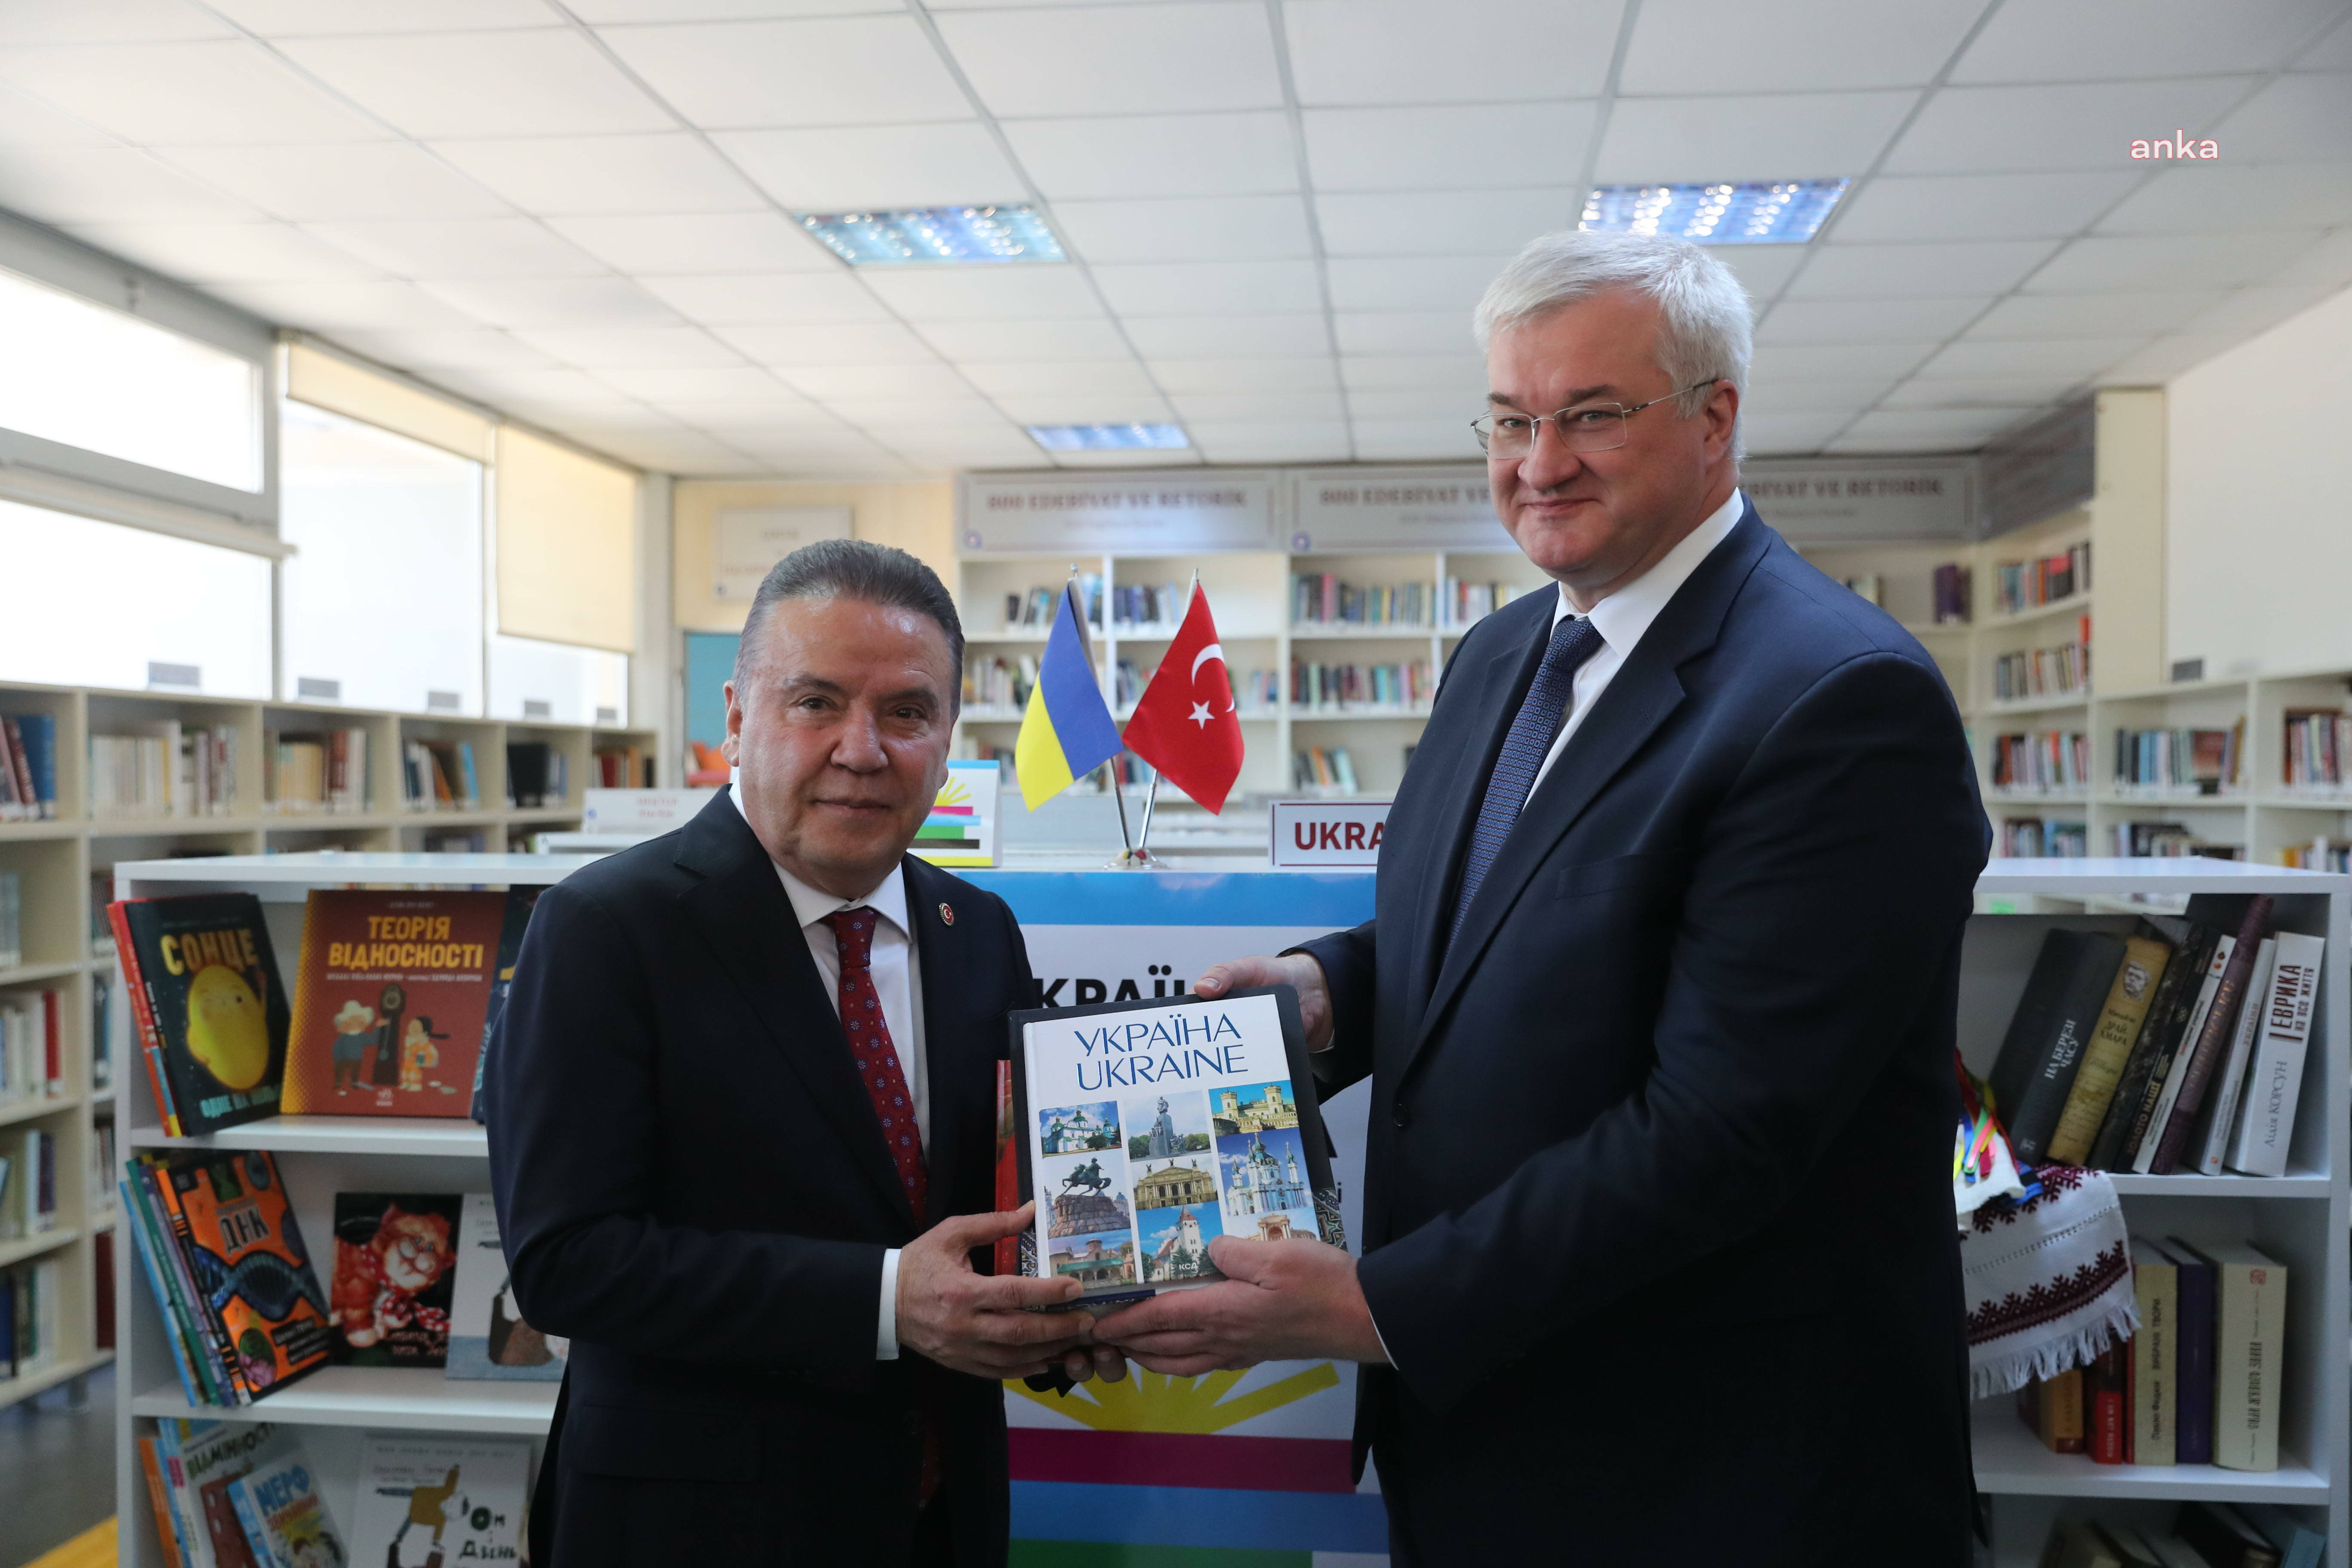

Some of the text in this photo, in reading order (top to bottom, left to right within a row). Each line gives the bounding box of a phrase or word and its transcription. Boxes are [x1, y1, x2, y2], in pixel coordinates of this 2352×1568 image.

[1295, 822, 1384, 850] UKRA
[368, 916, 451, 940] ТЕОРІЯ
[328, 942, 484, 971] ВІДНОСНОСТІ
[2271, 965, 2301, 1029] ЕВРИКА
[1074, 1013, 1242, 1057] УКРАЇНА
[1077, 1044, 1248, 1091] UKRAINE
[2268, 1060, 2287, 1115] КОРСУН
[220, 1208, 270, 1255] ДНК
